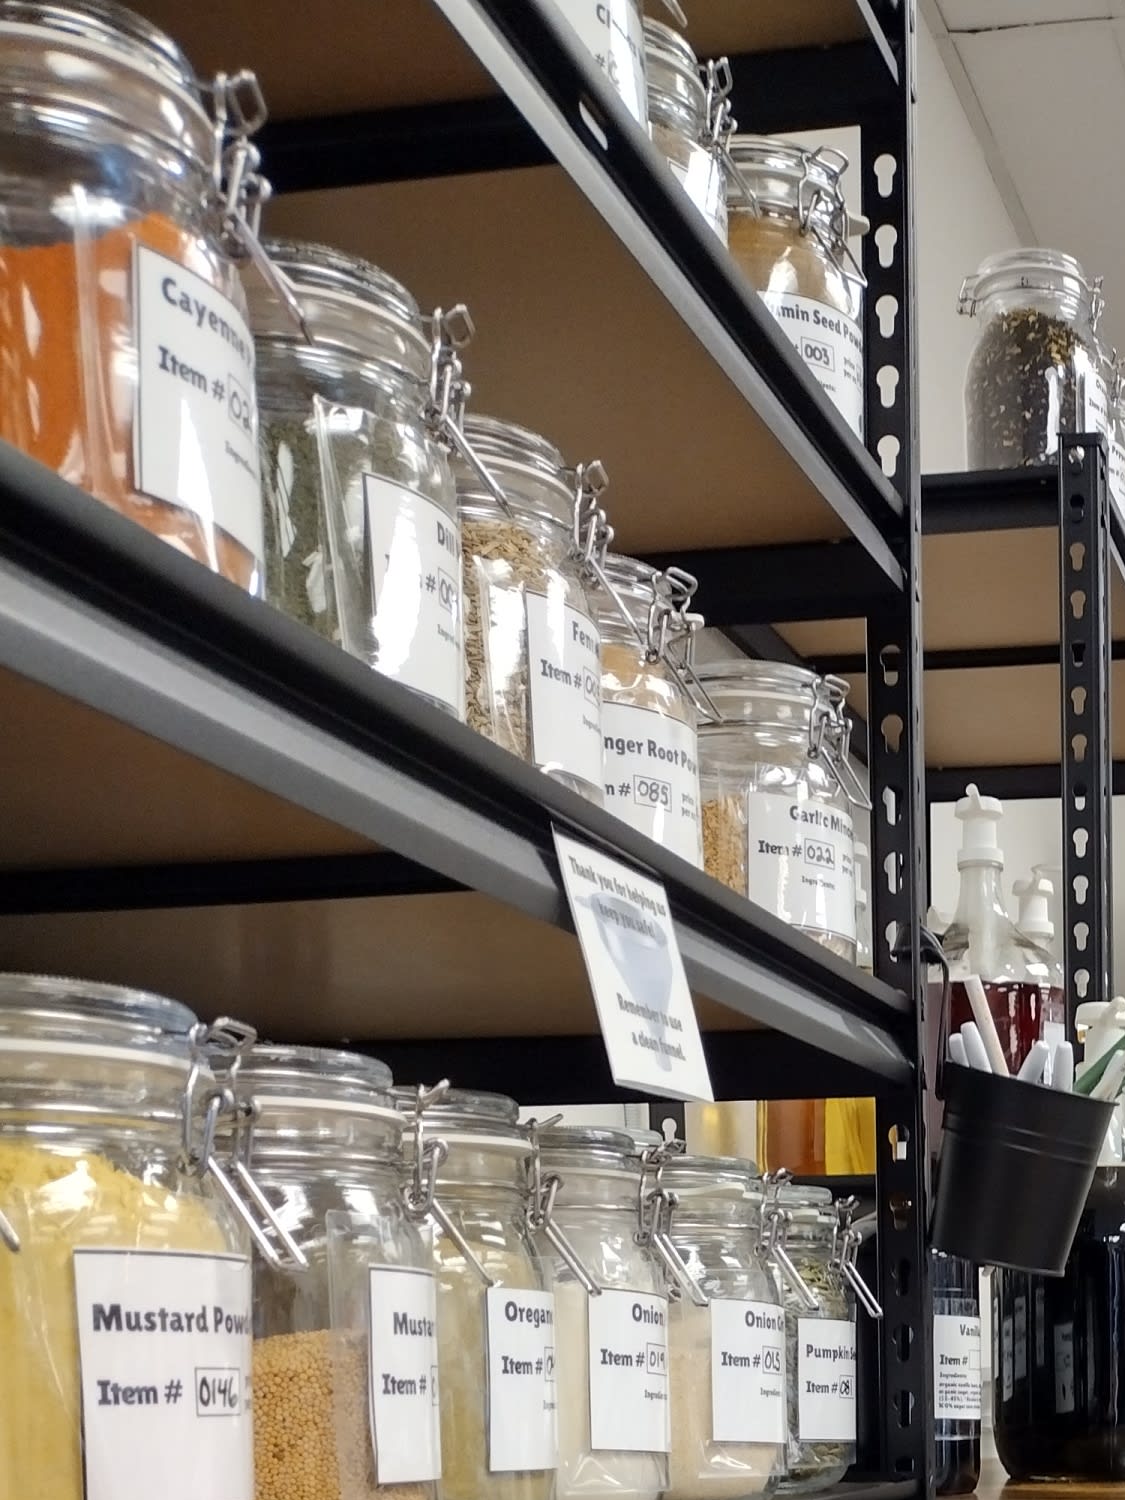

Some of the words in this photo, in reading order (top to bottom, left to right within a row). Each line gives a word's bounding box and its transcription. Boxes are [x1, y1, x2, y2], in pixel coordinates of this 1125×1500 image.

[813, 310, 841, 334] Seed
[805, 344, 830, 366] 003
[158, 345, 207, 393] Item
[540, 659, 572, 686] Item
[648, 740, 680, 765] Root
[789, 805, 829, 828] Garlic
[807, 844, 835, 865] 022
[569, 855, 598, 885] Thank
[598, 872, 616, 894] you
[615, 880, 628, 898] for
[627, 882, 658, 916] helping
[657, 903, 667, 917] us
[616, 992, 662, 1024] Remember
[669, 1015, 684, 1033] use
[638, 1030, 660, 1051] clean
[92, 1304, 208, 1333] Mustard
[632, 1303, 665, 1327] Onion
[745, 1310, 777, 1331] Onion
[600, 1348, 633, 1367] Item
[721, 1351, 750, 1368] Item
[806, 1344, 850, 1362] Pumpkin
[940, 1353, 961, 1366] Item
[501, 1355, 533, 1375] Item
[97, 1380, 158, 1406] Item
[164, 1379, 183, 1404] #
[382, 1373, 417, 1396] Item
[806, 1380, 830, 1394] Item
